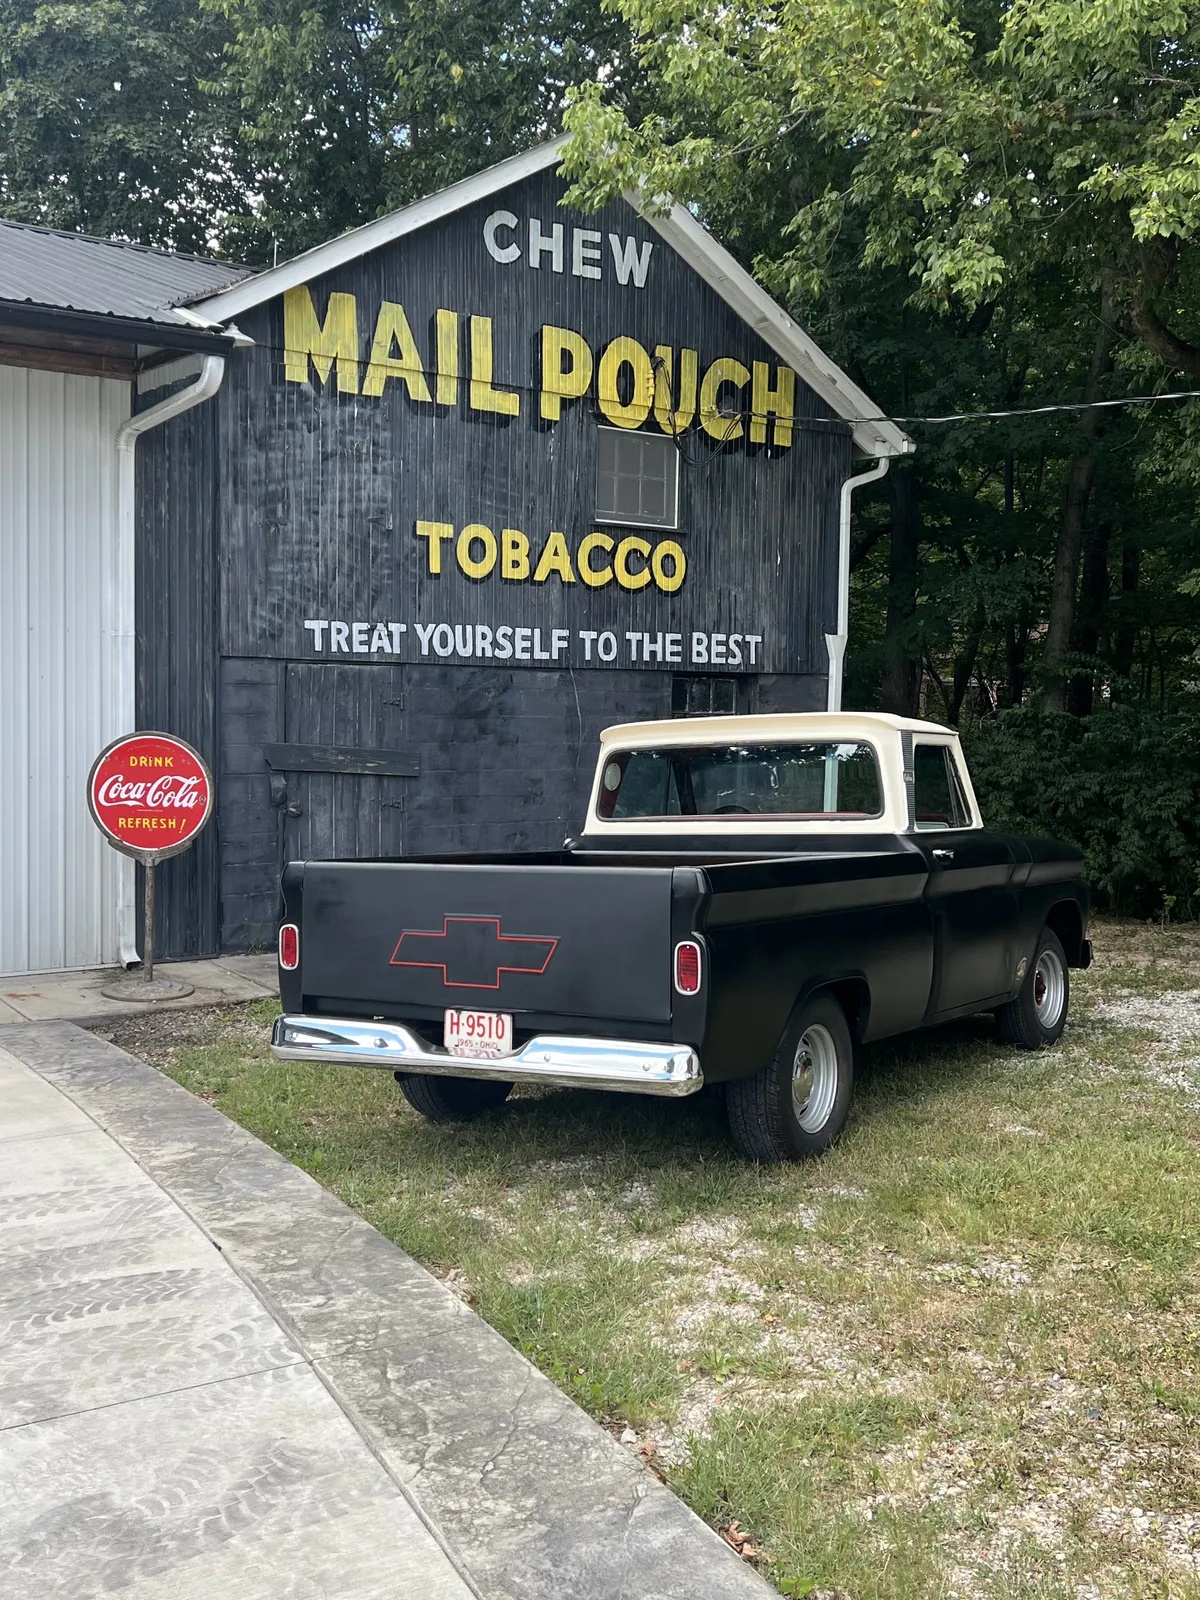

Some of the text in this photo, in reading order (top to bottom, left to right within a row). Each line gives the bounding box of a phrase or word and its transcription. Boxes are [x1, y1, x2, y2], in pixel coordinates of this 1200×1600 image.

[482, 210, 654, 288] CHEW
[283, 285, 796, 448] MAIL POUCH
[416, 520, 686, 592] TOBACCO
[304, 619, 763, 665] TREAT YOURSELF TO THE BEST
[130, 756, 173, 767] DRINK
[98, 774, 203, 808] Coca-Cola
[480, 1041, 497, 1049] OHIO
